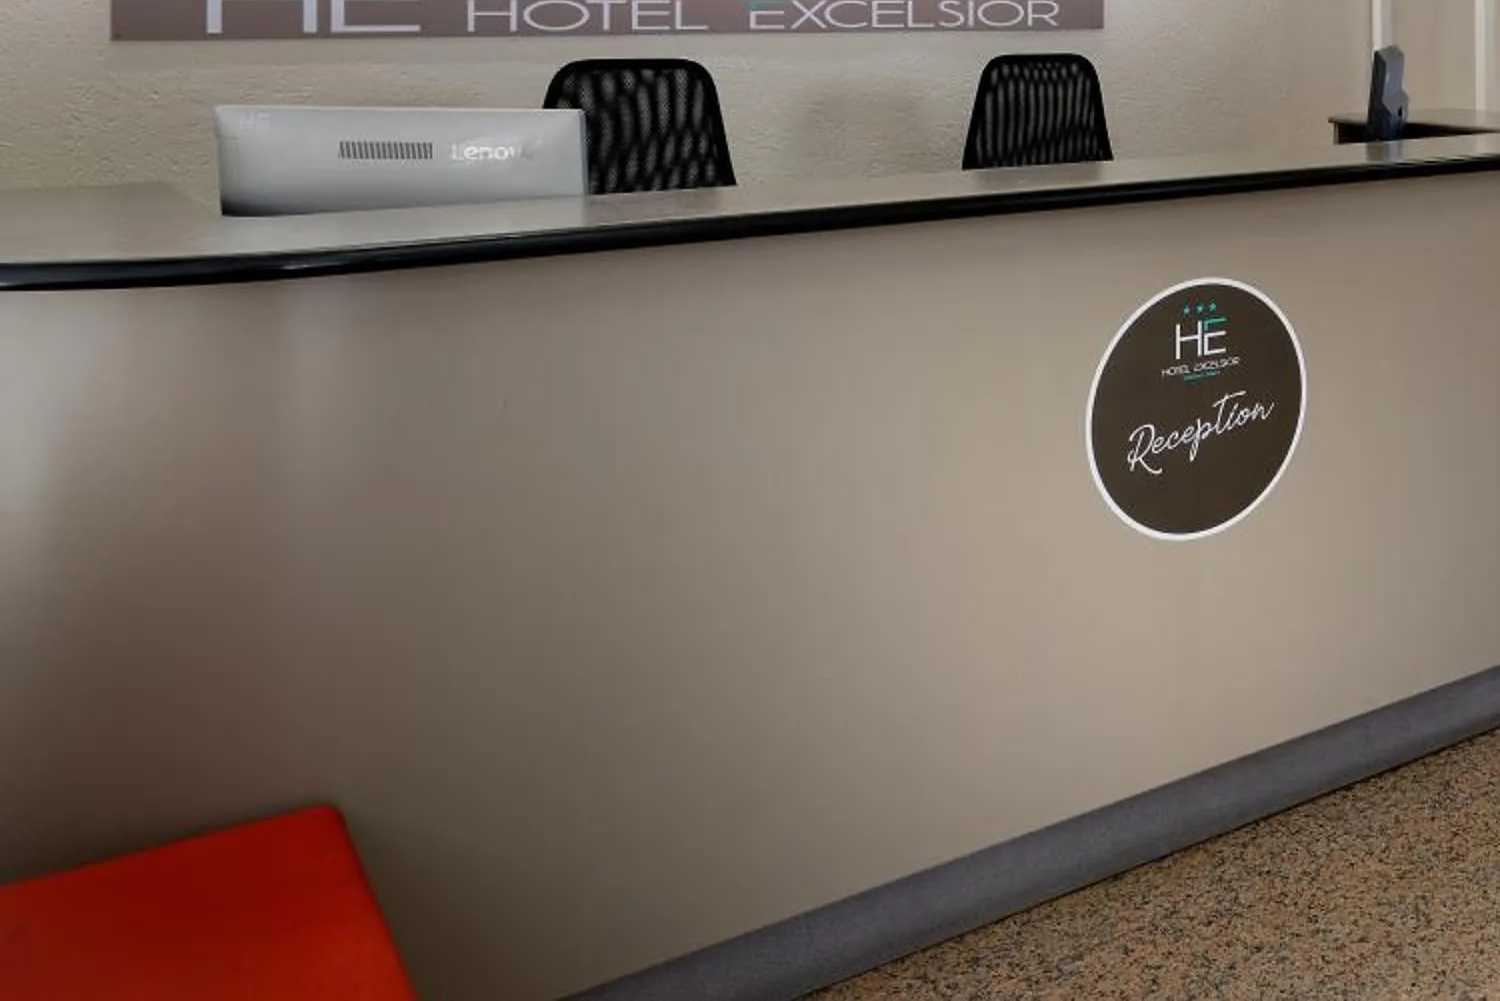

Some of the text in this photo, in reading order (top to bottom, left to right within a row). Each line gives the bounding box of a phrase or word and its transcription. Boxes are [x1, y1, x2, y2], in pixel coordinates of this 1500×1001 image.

[451, 142, 521, 160] Leno
[1175, 316, 1227, 360] HE
[1127, 390, 1275, 474] Reception
